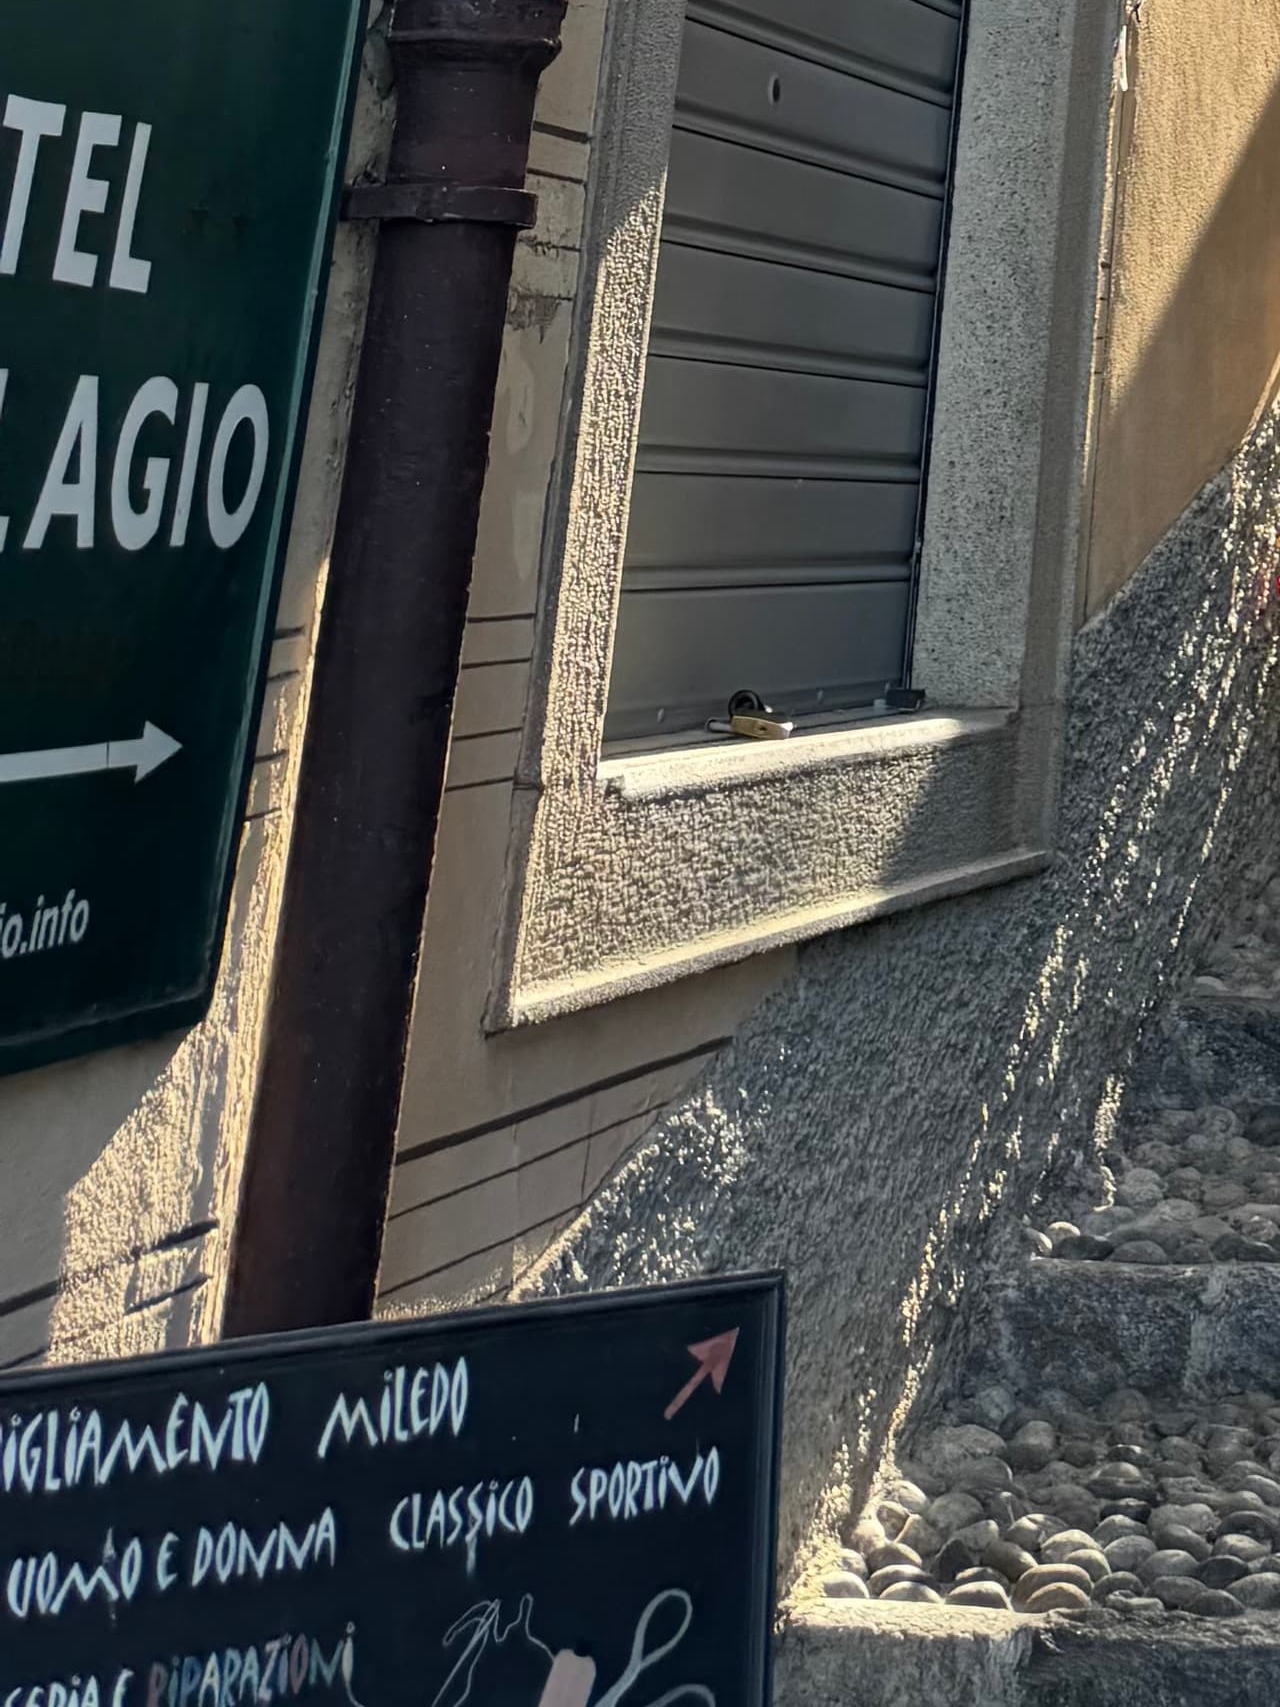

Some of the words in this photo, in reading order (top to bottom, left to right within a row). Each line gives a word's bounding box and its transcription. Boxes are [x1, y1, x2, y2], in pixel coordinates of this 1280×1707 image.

[0, 93, 153, 295] TEL
[0, 367, 270, 553] AGIO
[0, 1381, 270, 1493] IGLIAMENTO
[7, 1536, 143, 1618] UOMO
[156, 1531, 180, 1591] E
[192, 1507, 336, 1588] DONNA
[389, 1476, 534, 1551] CLASSICO
[569, 1446, 720, 1528] SPORTIVO
